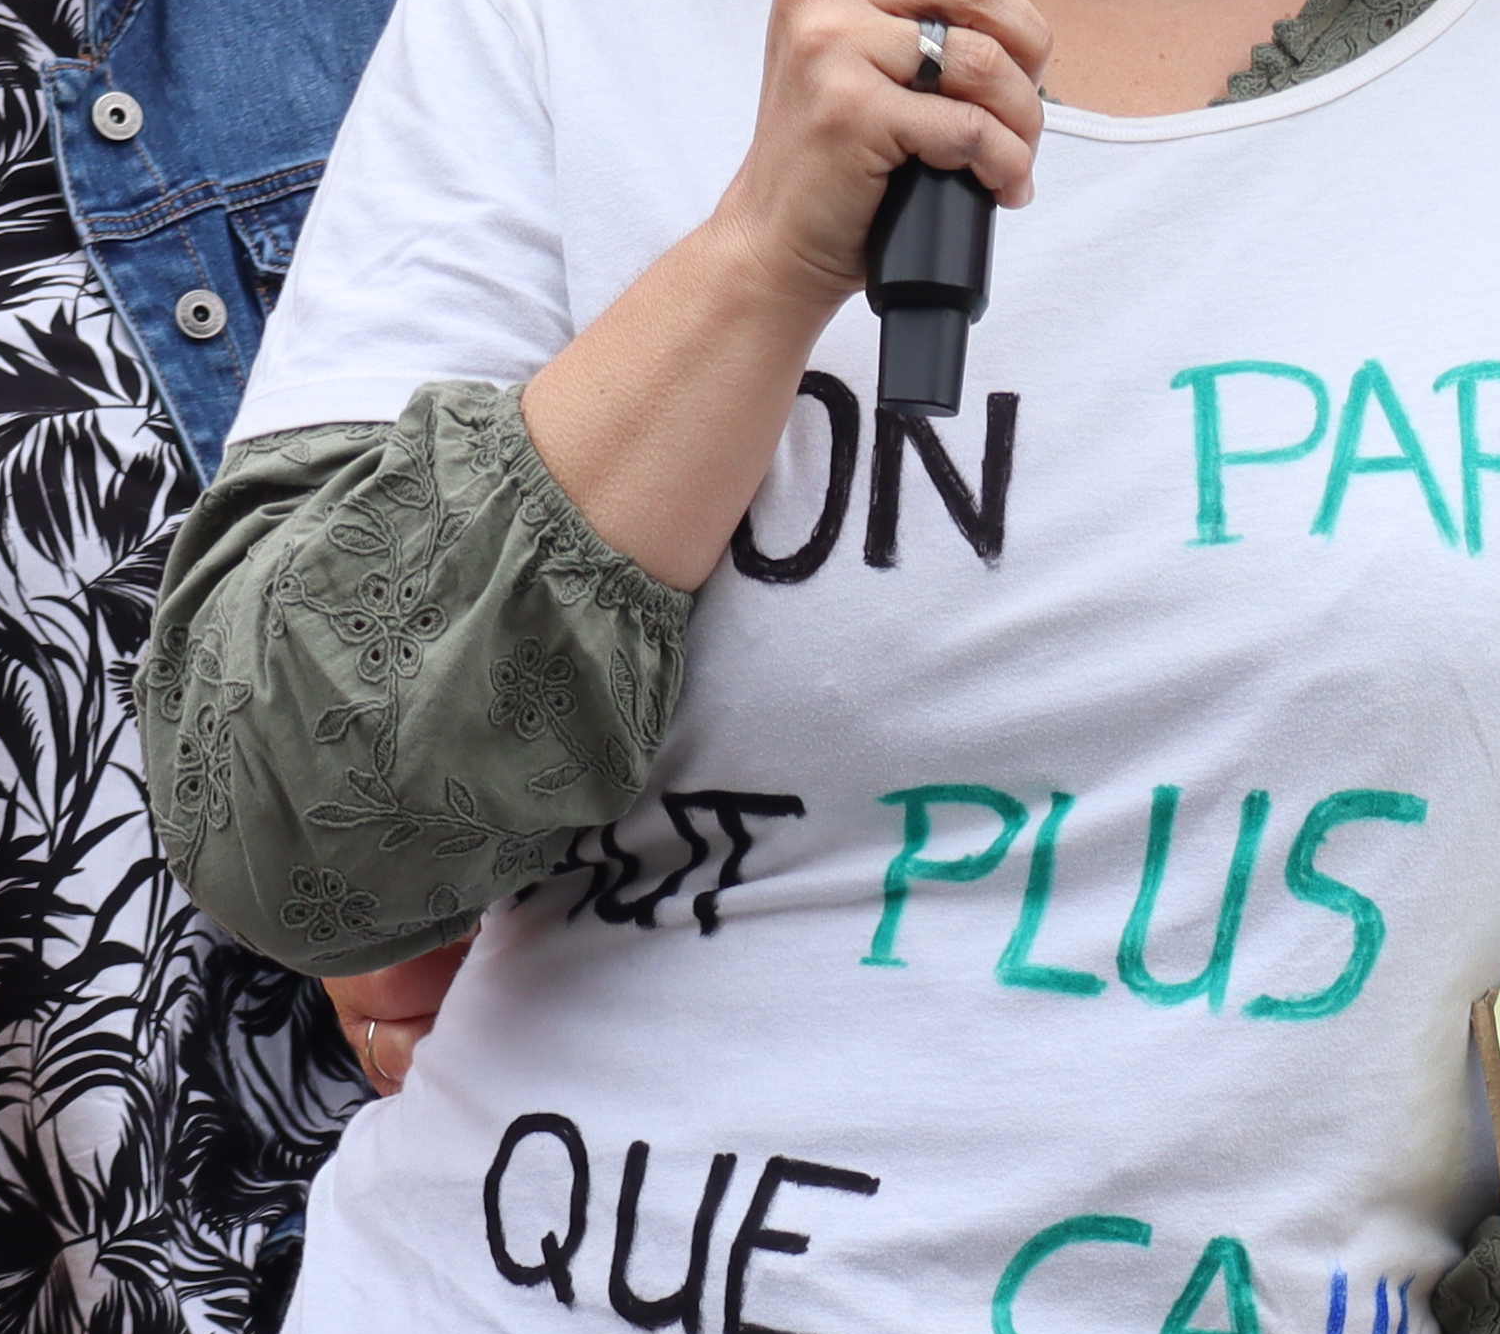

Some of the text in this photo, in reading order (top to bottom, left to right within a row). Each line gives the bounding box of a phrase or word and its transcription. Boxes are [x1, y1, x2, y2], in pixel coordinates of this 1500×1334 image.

[731, 370, 1020, 585] ON
[508, 783, 1429, 1024] AUT PLUS
